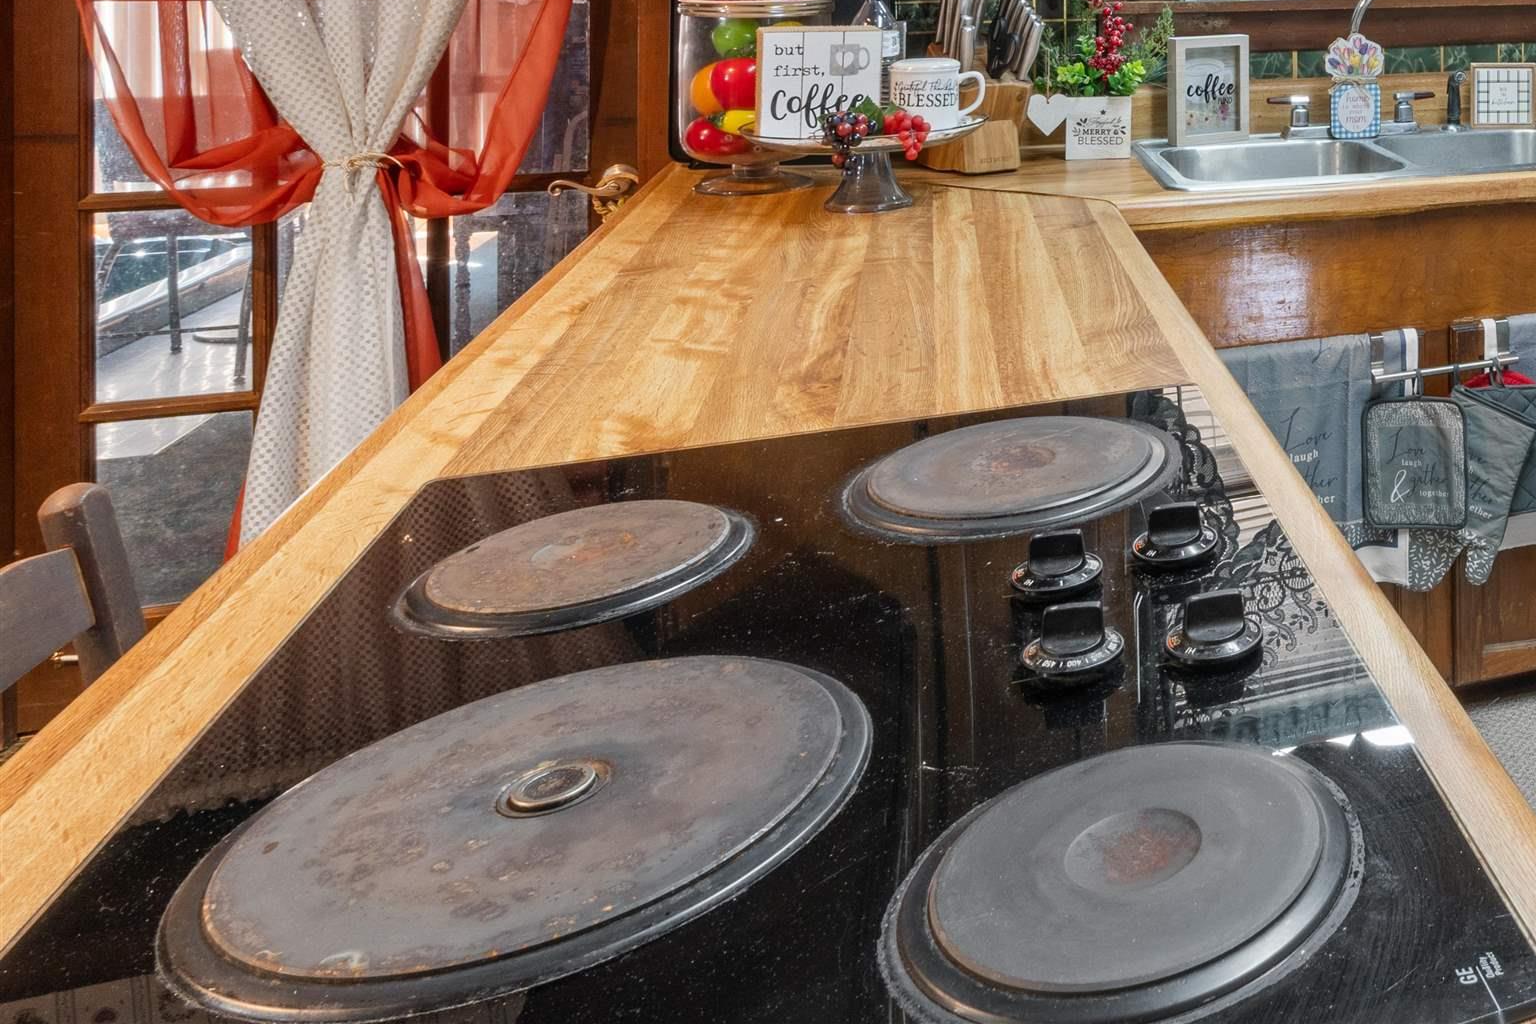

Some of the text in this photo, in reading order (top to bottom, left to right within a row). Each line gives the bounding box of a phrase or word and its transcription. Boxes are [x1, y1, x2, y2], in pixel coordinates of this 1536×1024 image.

[775, 44, 804, 56] but
[774, 65, 825, 77] first,
[1187, 74, 1236, 104] coffee
[898, 93, 956, 107] BLESSED
[1077, 136, 1124, 145] BLESSED
[1281, 407, 1333, 451] Love
[1386, 426, 1425, 464] Love
[1290, 450, 1319, 463] laugh
[1402, 458, 1422, 467] laugh
[1390, 469, 1410, 503] &
[1469, 505, 1493, 519] ether
[1456, 966, 1478, 984] GE
